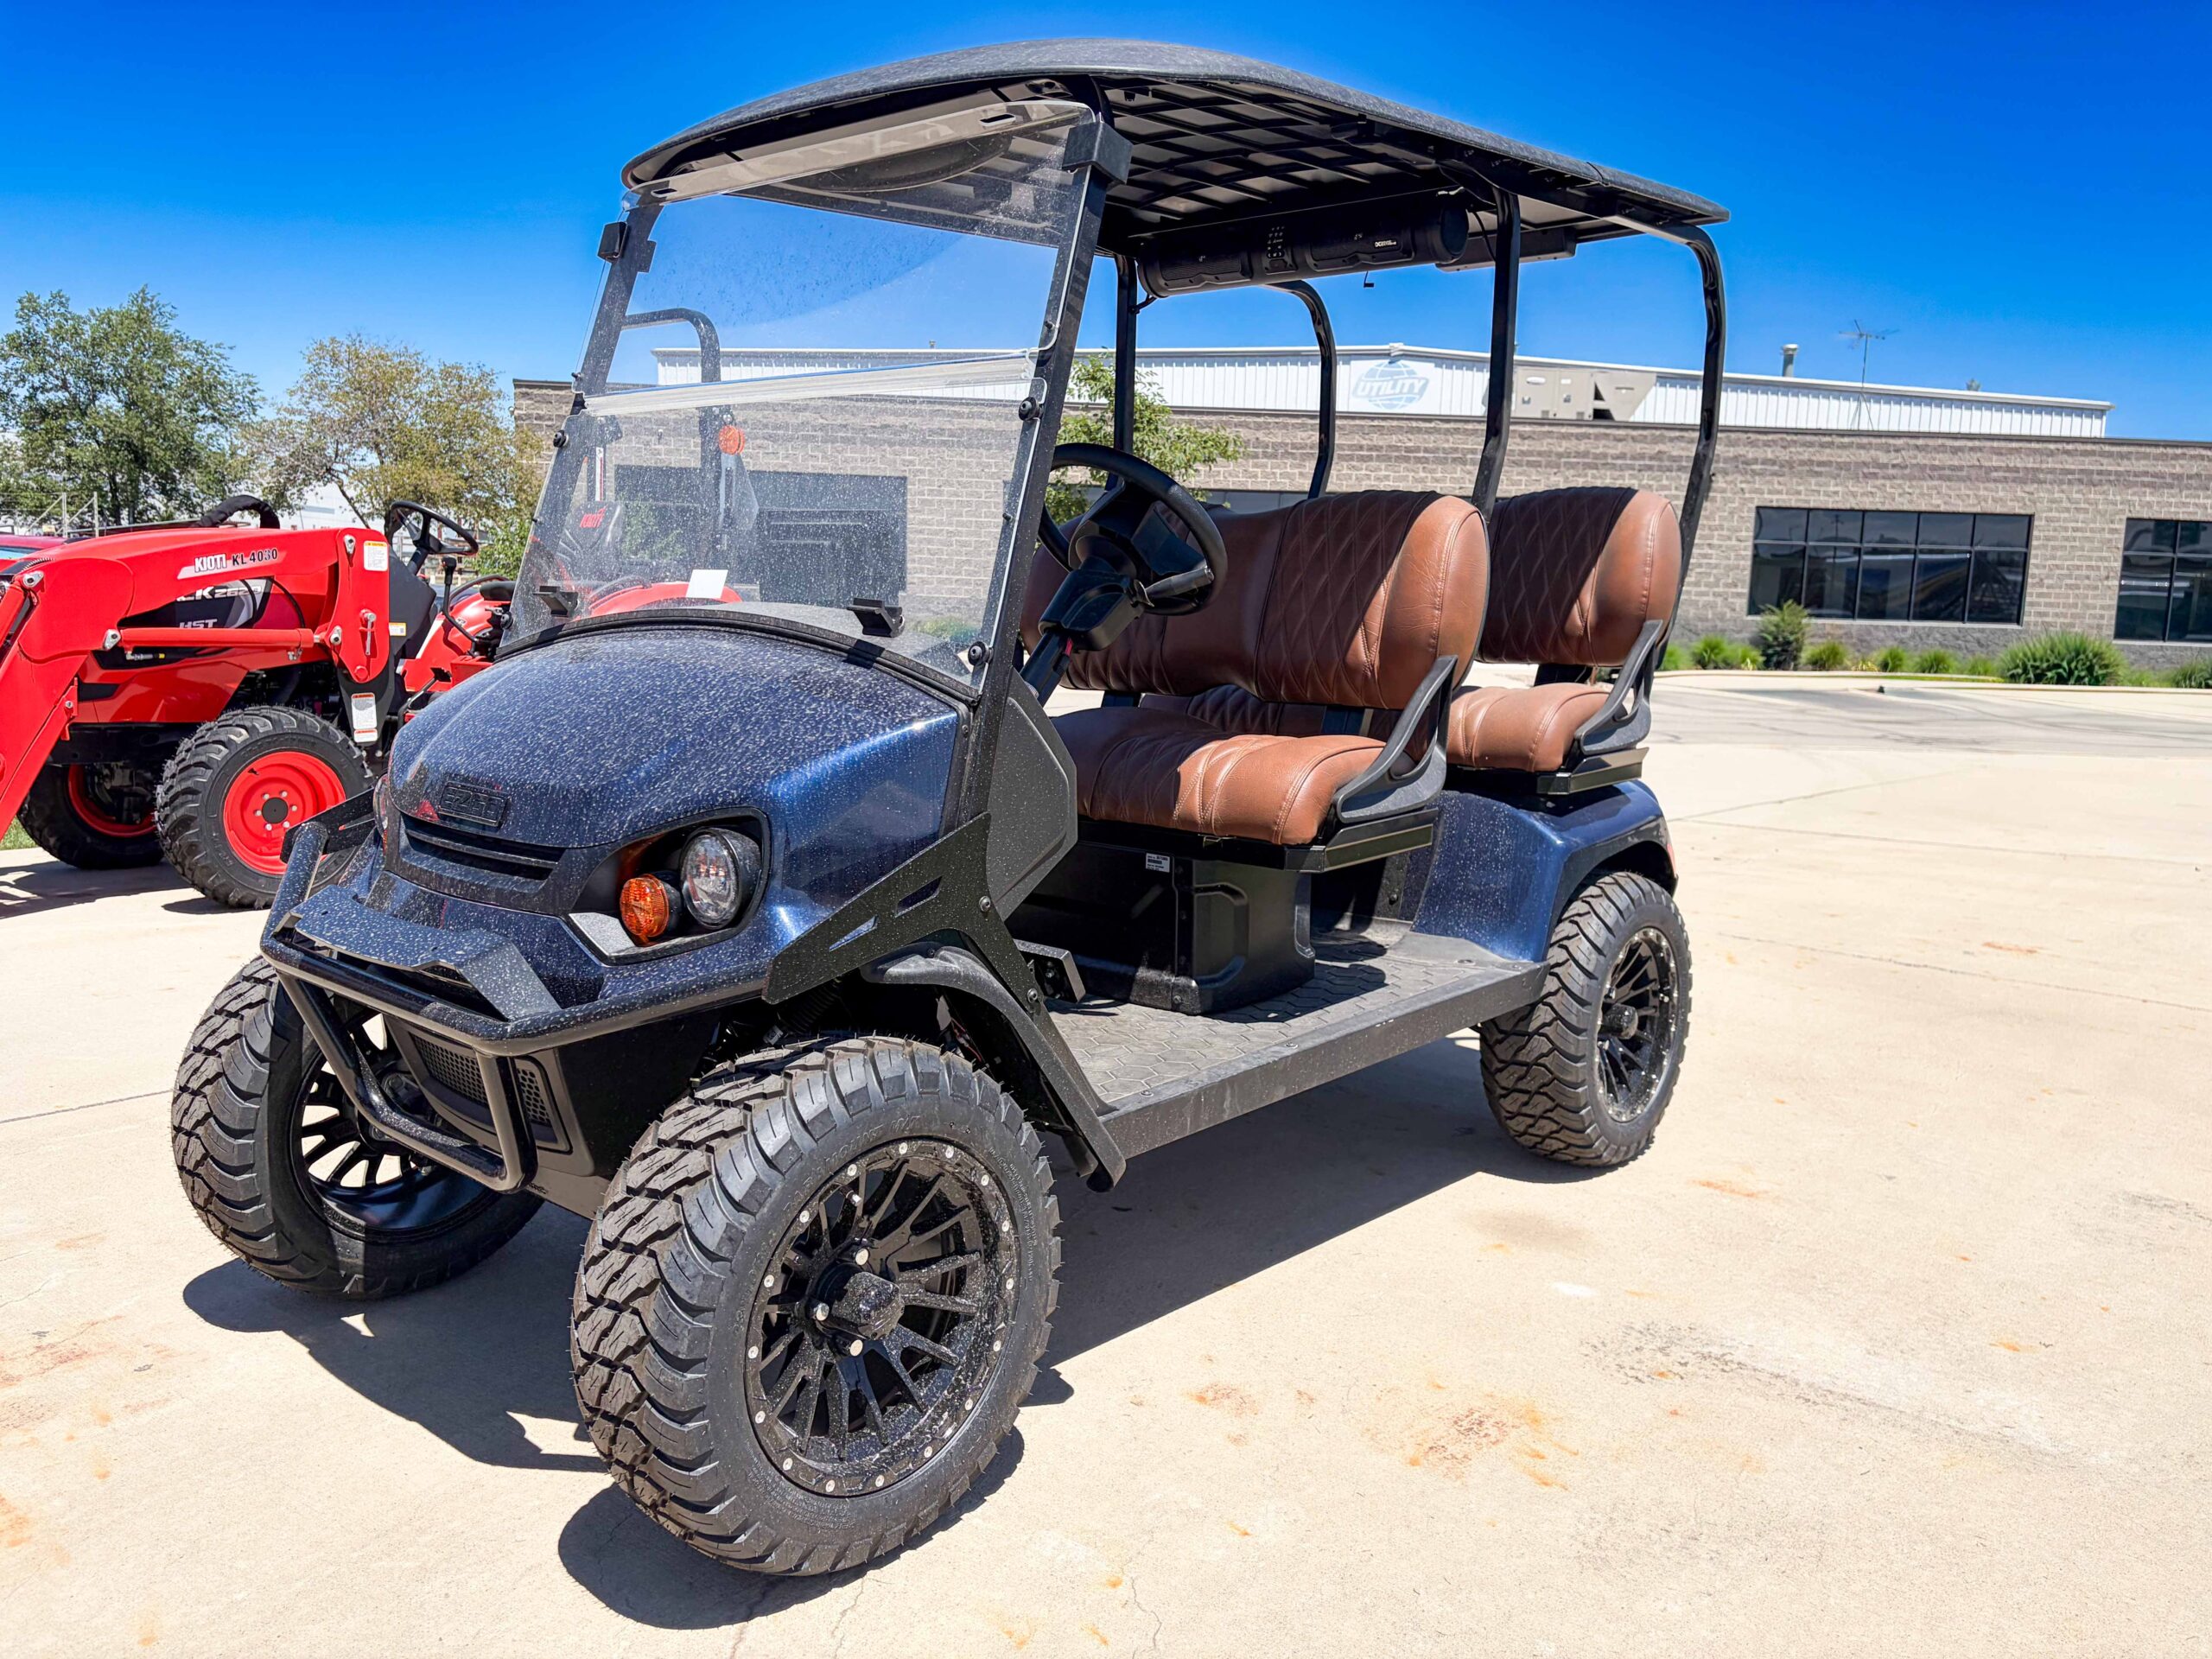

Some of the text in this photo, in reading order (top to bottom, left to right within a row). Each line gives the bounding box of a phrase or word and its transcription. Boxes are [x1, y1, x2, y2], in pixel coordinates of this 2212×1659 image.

[1357, 378, 1427, 397] UTILITY
[194, 549, 277, 573] KIOTI KL 4030
